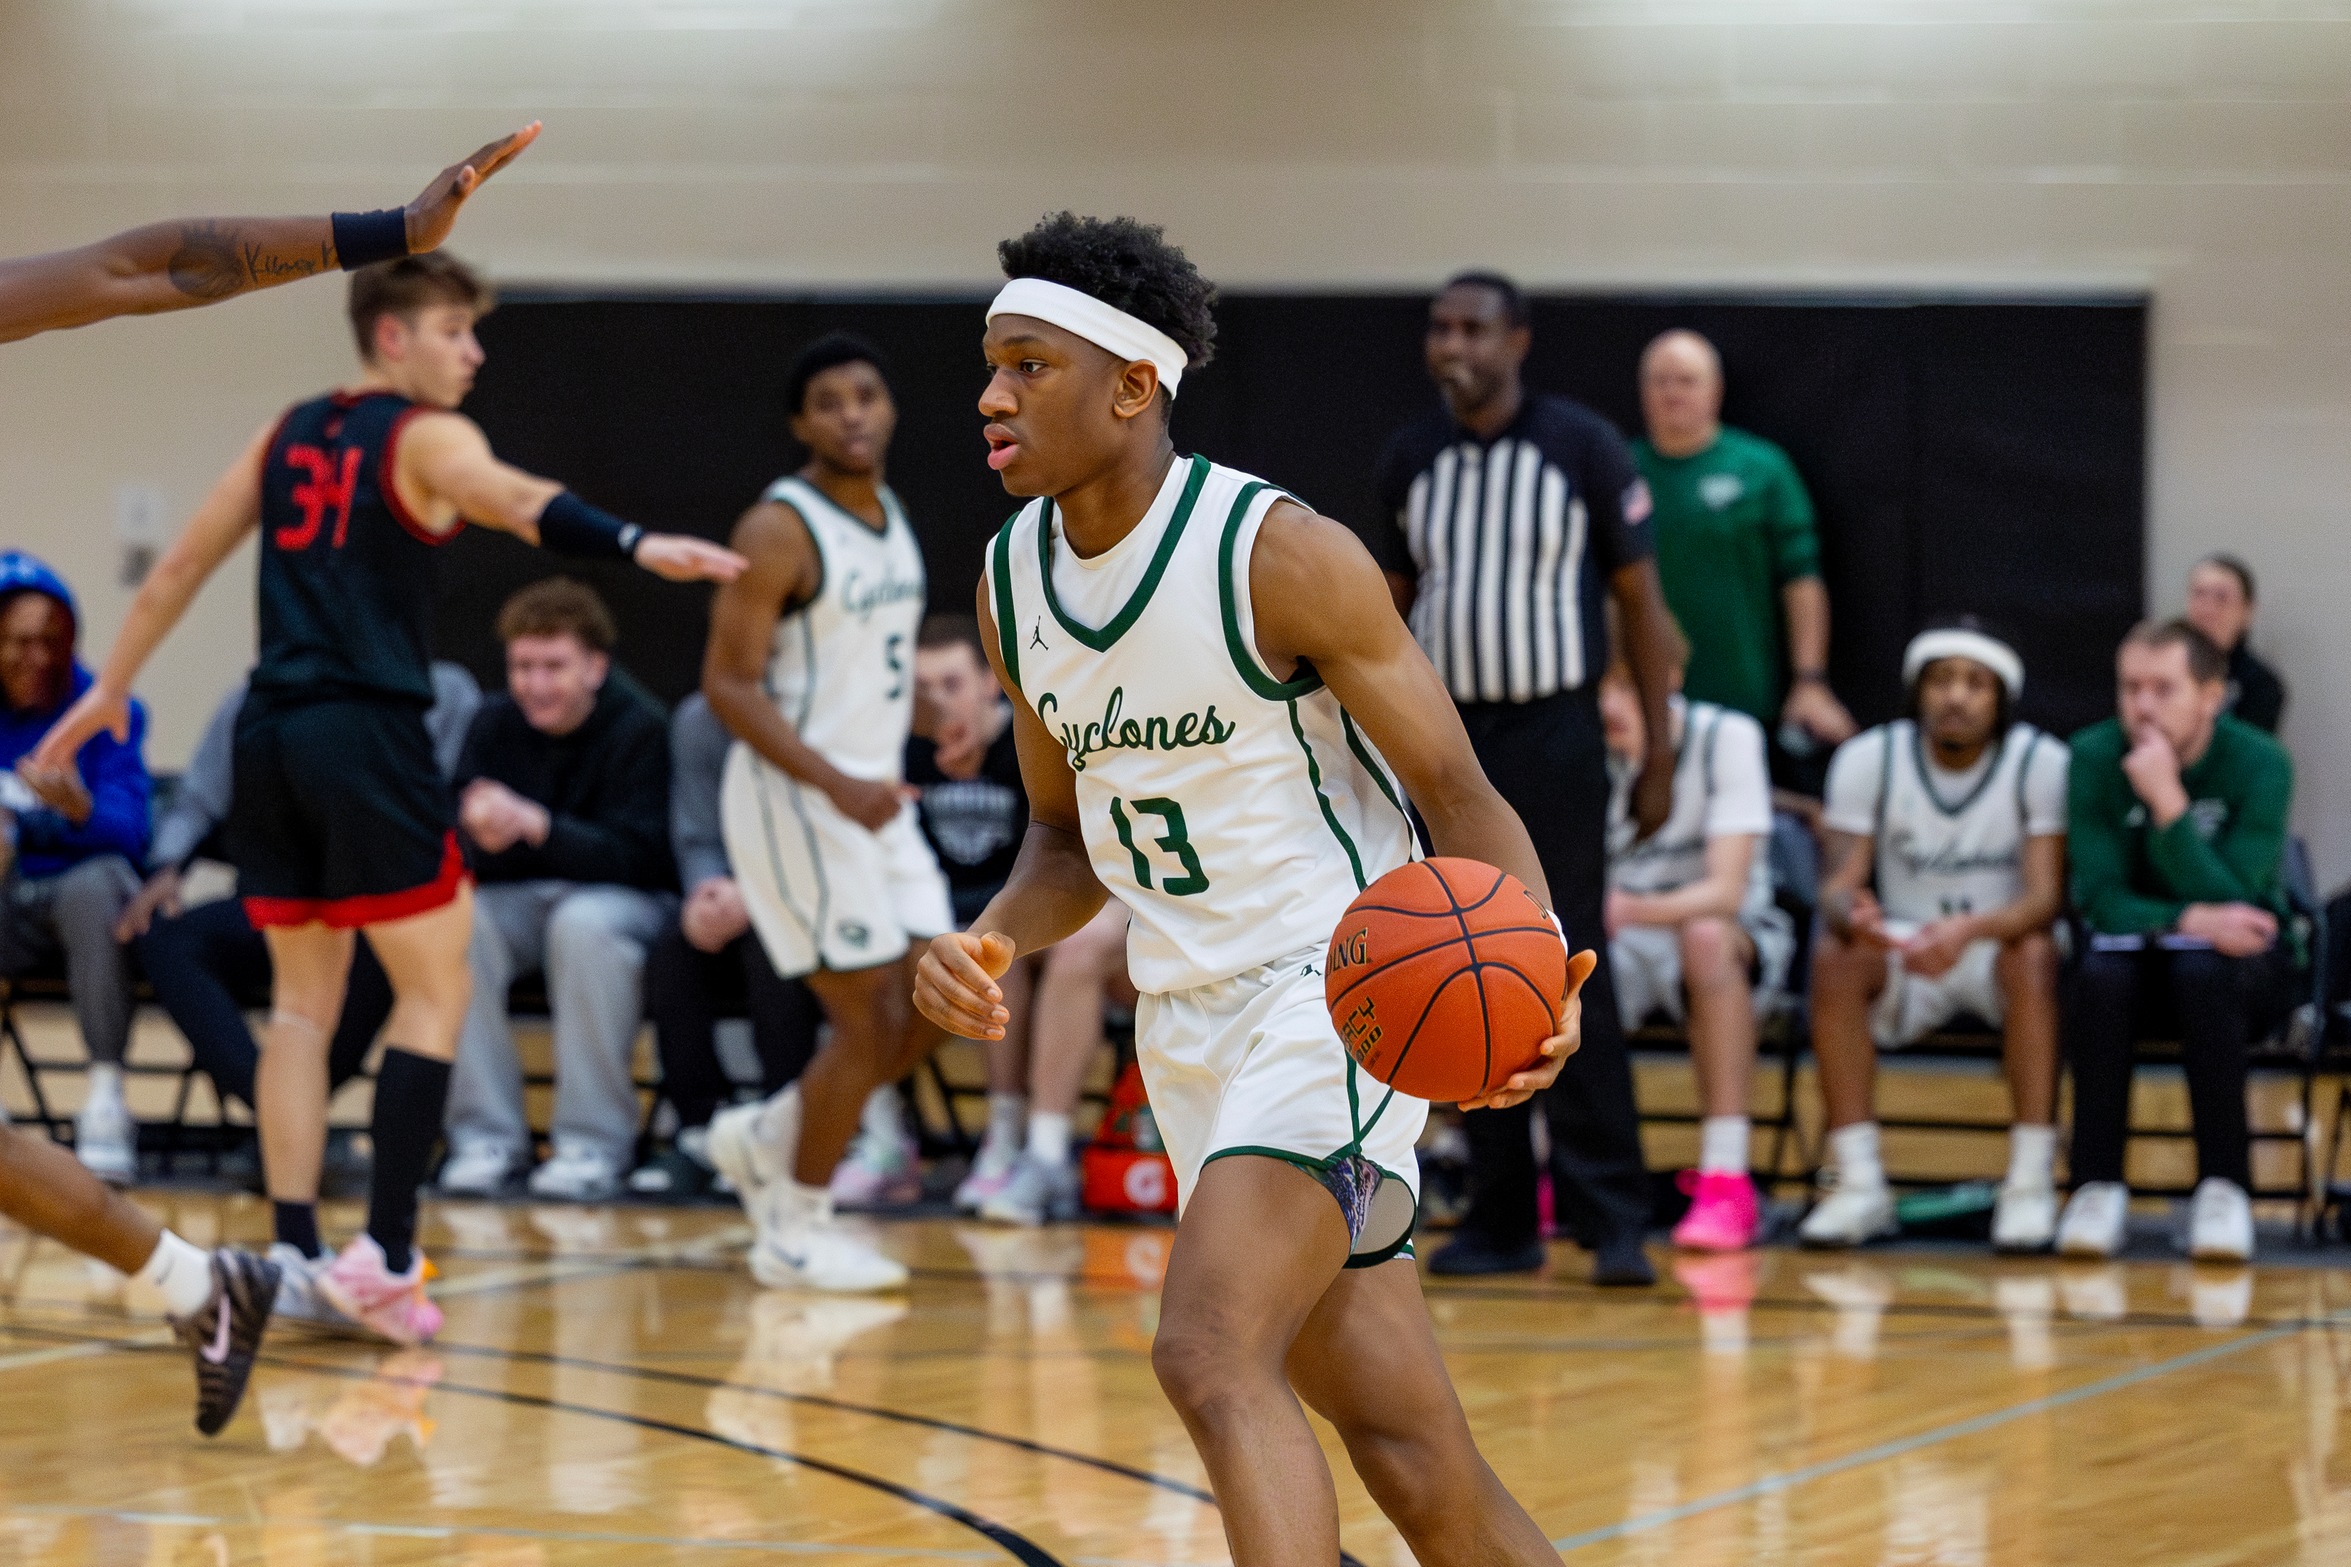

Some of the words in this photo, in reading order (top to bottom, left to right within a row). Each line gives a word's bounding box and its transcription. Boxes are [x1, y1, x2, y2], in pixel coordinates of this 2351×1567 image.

[275, 444, 364, 551] 34
[1038, 686, 1236, 772] Cyclones
[1109, 796, 1210, 896] 13
